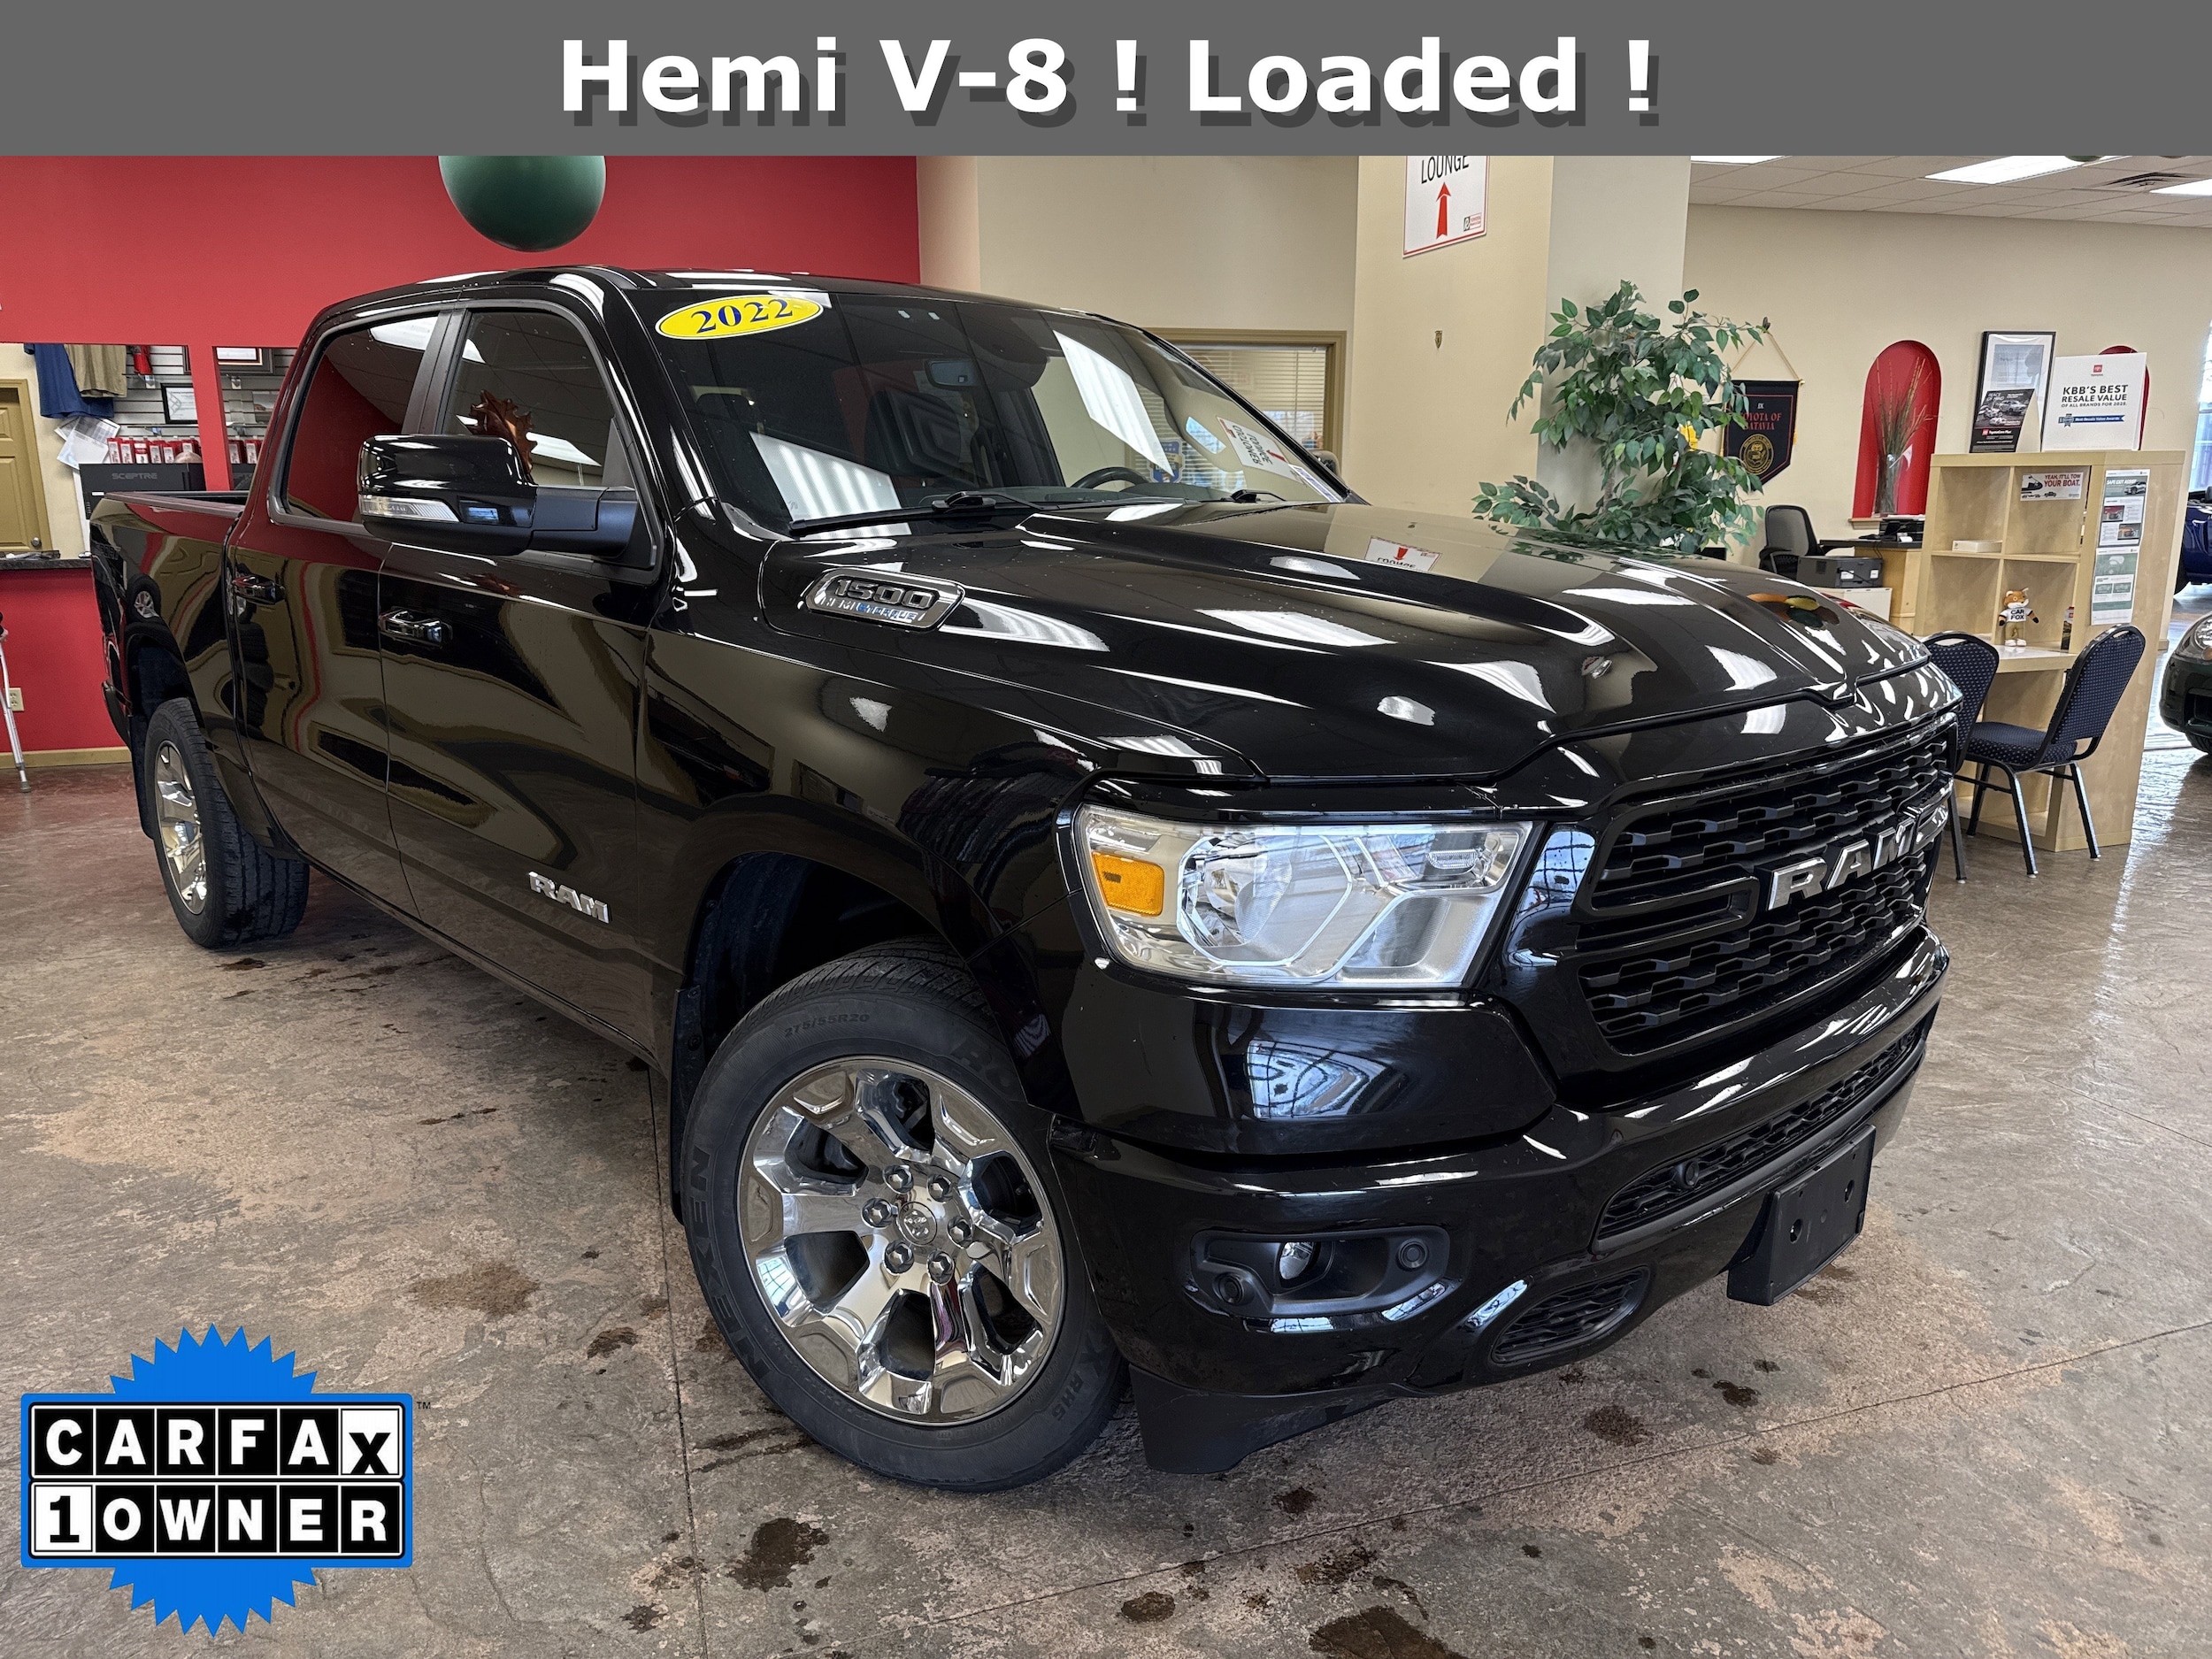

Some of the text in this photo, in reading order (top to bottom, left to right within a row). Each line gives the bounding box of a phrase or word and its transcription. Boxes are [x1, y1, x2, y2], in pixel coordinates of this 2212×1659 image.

[1421, 156, 1470, 184] LOUNGE
[691, 298, 794, 334] 2022
[2062, 384, 2129, 396] KBB'S BEST
[1747, 421, 1775, 430] ATAVIA
[1770, 412, 1782, 421] OF
[834, 579, 938, 610] 1500
[1768, 818, 1916, 910] RAM
[528, 872, 610, 924] RAM
[784, 1013, 871, 1038] 275/55R20
[690, 1145, 772, 1379] NEXEN
